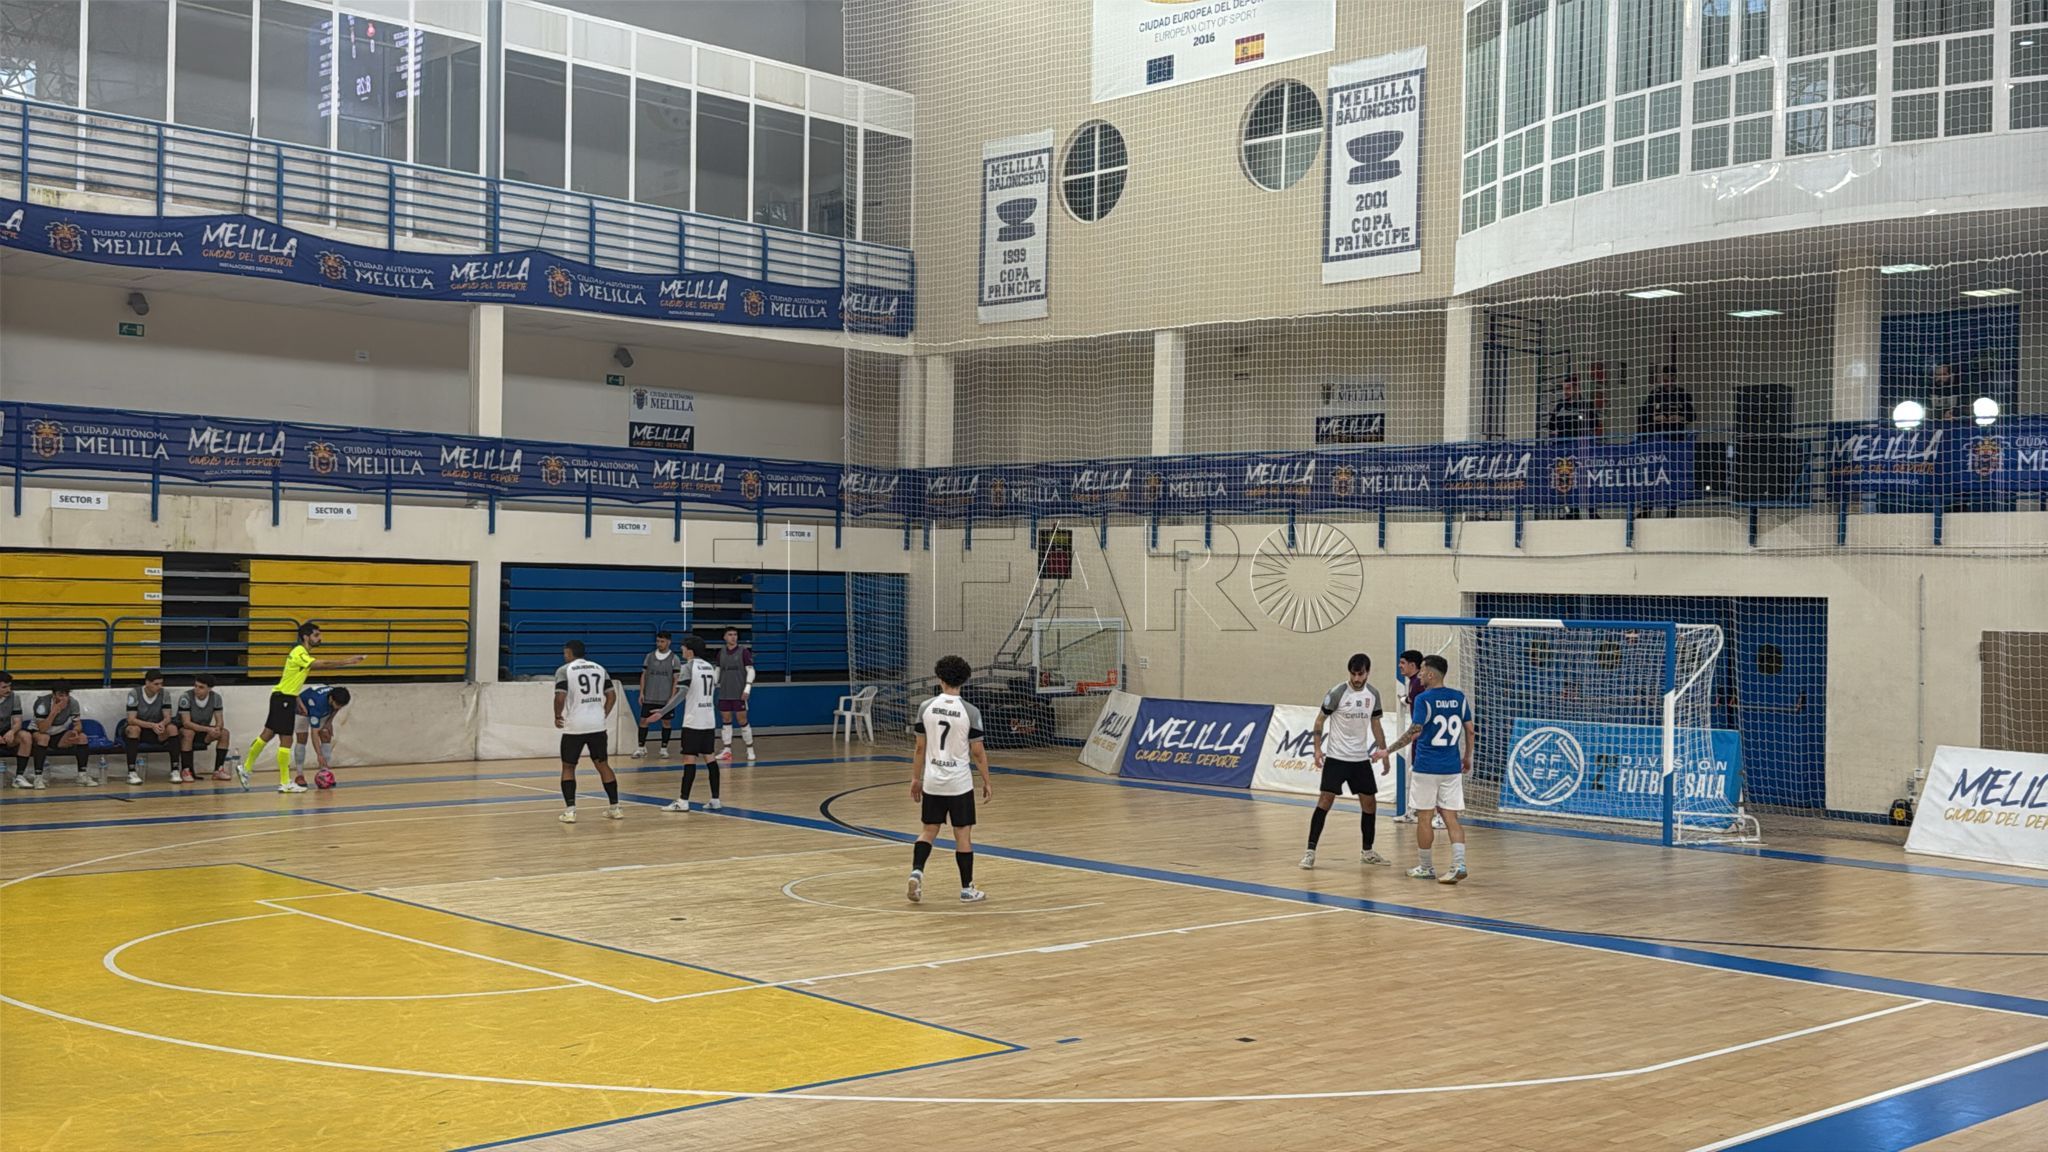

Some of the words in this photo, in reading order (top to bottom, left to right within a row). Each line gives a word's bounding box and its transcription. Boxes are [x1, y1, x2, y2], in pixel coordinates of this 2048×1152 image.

[1139, 17, 1171, 33] CIUDAD
[1172, 7, 1213, 24] EUROPEA
[1214, 3, 1231, 14] DEL
[1154, 27, 1197, 43] EUROPEAN
[1198, 20, 1216, 32] CITY
[1217, 17, 1229, 28] OF
[1229, 9, 1257, 25] SPORT
[1193, 32, 1216, 47] 2016
[1339, 79, 1413, 109] MELILLA
[1335, 95, 1416, 126] BALONCESTO
[991, 156, 1044, 177] MELILLA
[988, 169, 1046, 192] BALONCESTO
[1356, 190, 1388, 212] 2001
[1351, 213, 1393, 234] COPA
[91, 229, 126, 238] CIUDAD
[128, 230, 183, 239] AUTÓNOMA
[202, 223, 298, 258] MELILLA
[1335, 227, 1410, 252] PRINCIPE
[92, 237, 183, 256] MELILLA
[1003, 248, 1026, 264] 1999
[202, 248, 236, 259] CIUDAD
[238, 252, 254, 261] DEL
[259, 254, 294, 268] DEPORTE
[353, 260, 383, 271] CIUDAD
[354, 269, 435, 290] MELILLA
[450, 257, 531, 282] MELILLA
[576, 274, 603, 284] CIUDAD
[1000, 267, 1029, 283] COPA
[497, 282, 528, 291] DEPORTE
[579, 283, 647, 305] MELILLA
[658, 278, 728, 301] MELILLA
[988, 279, 1041, 298] PRINCIPE
[769, 294, 793, 302] CIUDAD
[839, 294, 899, 315] MELILLA
[770, 302, 828, 318] MELILLA
[650, 398, 693, 412] MELILLA
[72, 425, 109, 435] CIUDAD
[111, 428, 169, 440] AUTÓNOMA
[632, 425, 691, 442] MELILLA
[1320, 415, 1381, 435] MELILLA
[75, 436, 169, 460] MELILLA
[188, 426, 285, 457] MELILLA
[1831, 430, 1943, 462] MELILLA
[224, 457, 241, 466] DEL
[343, 446, 373, 455] CIUDAD
[375, 447, 423, 458] AUTÓNOMA
[440, 445, 523, 473] MELILLA
[1585, 458, 1616, 467] CIUDAD
[1618, 454, 1669, 466] AUTÓNOMA
[2017, 450, 2048, 471] ME
[346, 456, 425, 475] MELILLA
[571, 458, 599, 467] CIUDAD
[600, 460, 639, 470] AUTÓNOMA
[652, 459, 725, 483] MELILLA
[1245, 459, 1316, 485] MELILLA
[1445, 452, 1531, 479] MELILLA
[574, 469, 640, 489] MELILLA
[788, 475, 826, 483] AUTÓNOMA
[838, 473, 900, 494] MELILLA
[927, 474, 980, 495] MELILLA
[1072, 468, 1132, 491] MELILLA
[1362, 474, 1430, 493] MELILLA
[1588, 467, 1671, 488] MELILLA
[768, 483, 826, 497] MELILLA
[1012, 488, 1060, 502] MELILLA
[1169, 480, 1227, 498] MELILLA
[59, 495, 93, 504] SECTOR
[95, 497, 101, 505] 5
[315, 506, 344, 515] SECTOR
[346, 508, 352, 516] 6
[578, 673, 601, 695] 97
[701, 673, 714, 696] 17
[1436, 699, 1459, 708] DAVID
[938, 720, 951, 750] 7
[1138, 717, 1256, 754] MELILLA
[1432, 715, 1462, 746] 29
[1135, 750, 1173, 762] CIUDAD
[1174, 752, 1193, 764] DEL
[1196, 753, 1241, 768] DEPORTE
[1273, 759, 1306, 769] CIUDAD
[1308, 762, 1321, 772] DE
[1622, 755, 1728, 772] DIVSIÓN
[1618, 766, 1677, 796] FÚTBL
[1685, 773, 1726, 799] SALA
[1944, 807, 1993, 824] CIUDAD
[1995, 811, 2020, 826] DEL
